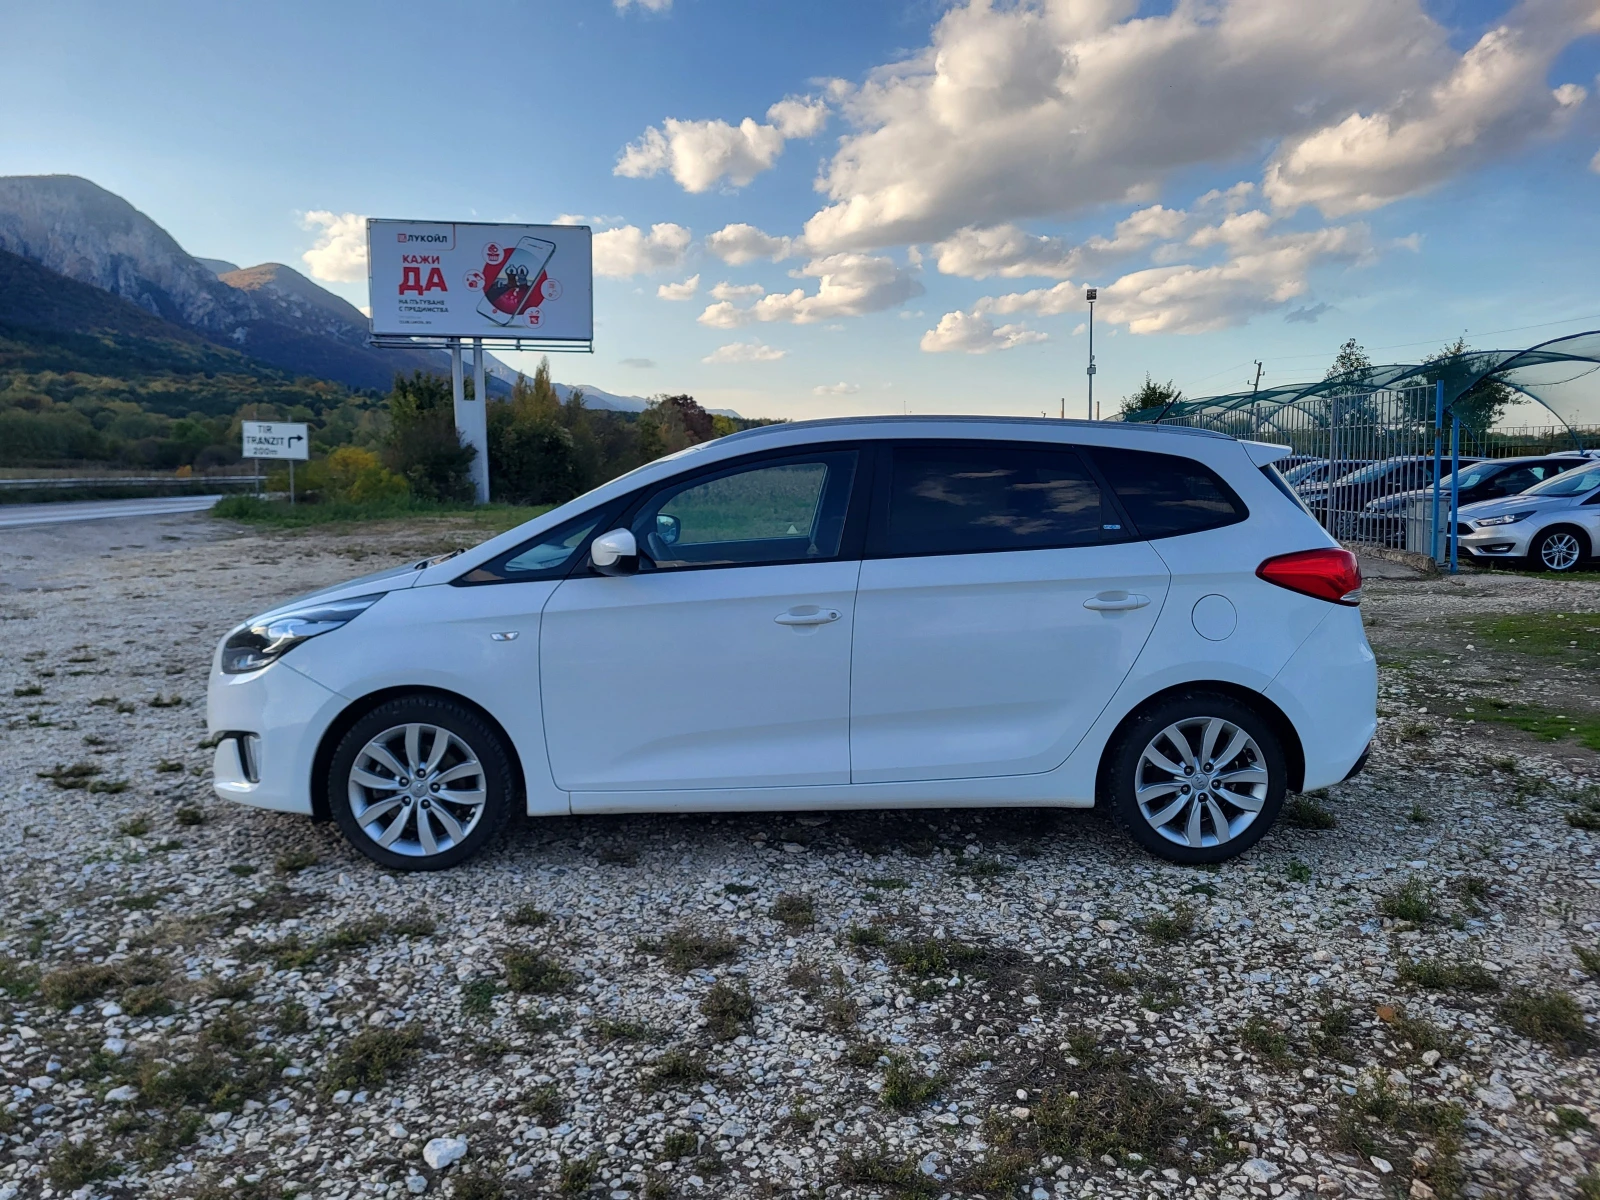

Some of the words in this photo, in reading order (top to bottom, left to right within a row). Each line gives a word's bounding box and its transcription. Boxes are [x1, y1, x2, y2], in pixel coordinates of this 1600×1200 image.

[407, 234, 448, 243] ЛУКОЙЛ
[402, 254, 440, 264] КАЖИ
[399, 266, 448, 295] ДА
[257, 425, 273, 434] TIR
[246, 436, 285, 446] TRANZIT
